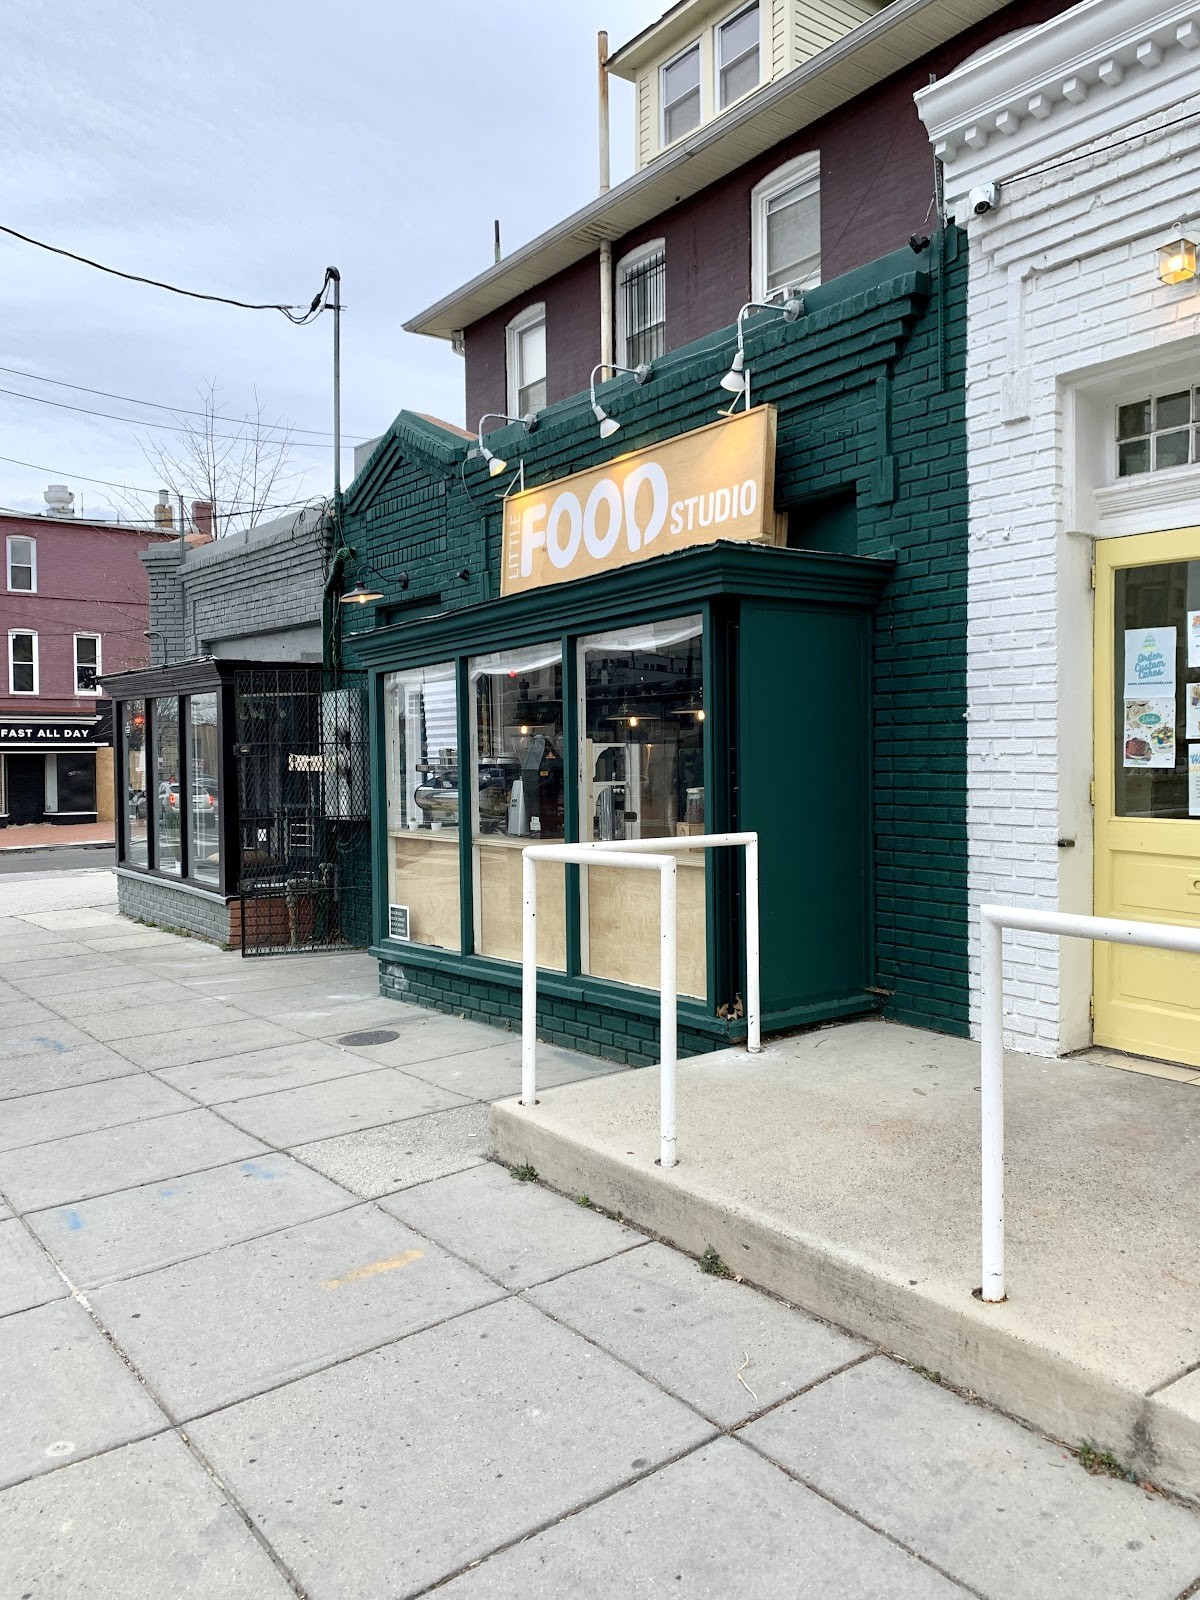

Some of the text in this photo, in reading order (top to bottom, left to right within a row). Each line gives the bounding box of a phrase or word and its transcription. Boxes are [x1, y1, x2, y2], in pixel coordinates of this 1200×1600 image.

[520, 462, 757, 578] FOOD STUDIO
[508, 512, 521, 580] LITTLE
[1138, 651, 1163, 664] Order
[1135, 660, 1166, 673] Custom
[1139, 669, 1164, 679] Cakes
[0, 728, 89, 738] FAST ALL DAY
